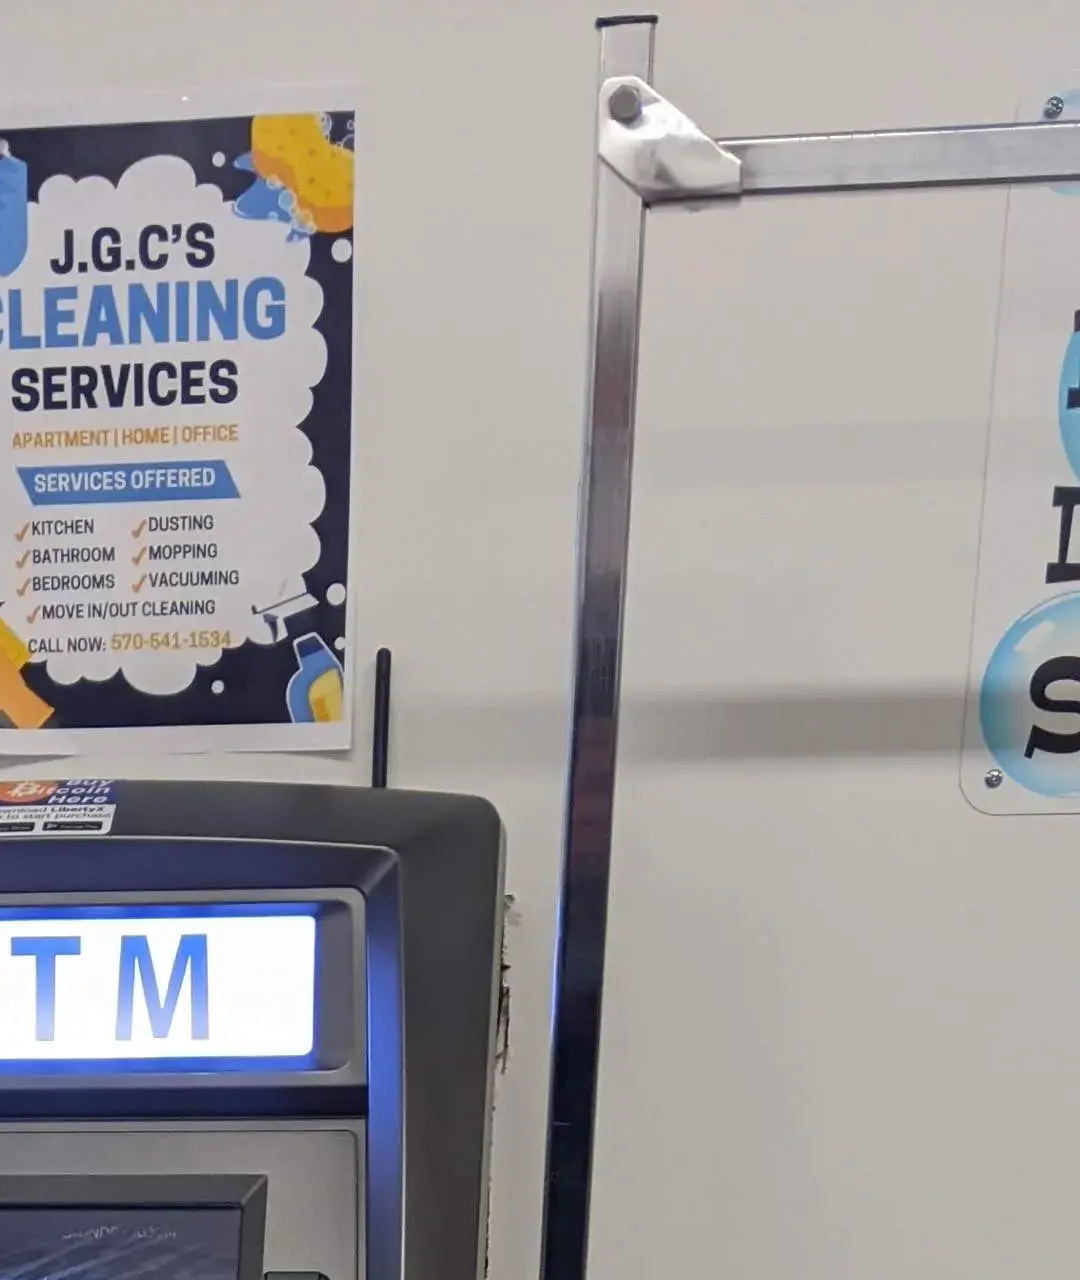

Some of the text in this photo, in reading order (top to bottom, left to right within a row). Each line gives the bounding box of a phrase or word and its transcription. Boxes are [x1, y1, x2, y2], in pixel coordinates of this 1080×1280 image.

[11, 359, 239, 412] SERVICES
[12, 424, 239, 450] APARTMENT HOME OFFICE
[35, 467, 216, 493] SERVICES OFFERED
[32, 519, 94, 536] KITCHEN
[148, 515, 213, 532] DUSTING
[33, 547, 115, 564] BATHROOM
[149, 544, 218, 560] MOPPING
[33, 575, 115, 591] BEDROOMS
[149, 571, 239, 588] VACUUMING
[42, 600, 215, 620] MOVE IN/OUT CLEANING
[29, 638, 64, 654] CALL
[68, 637, 106, 652] NOW:
